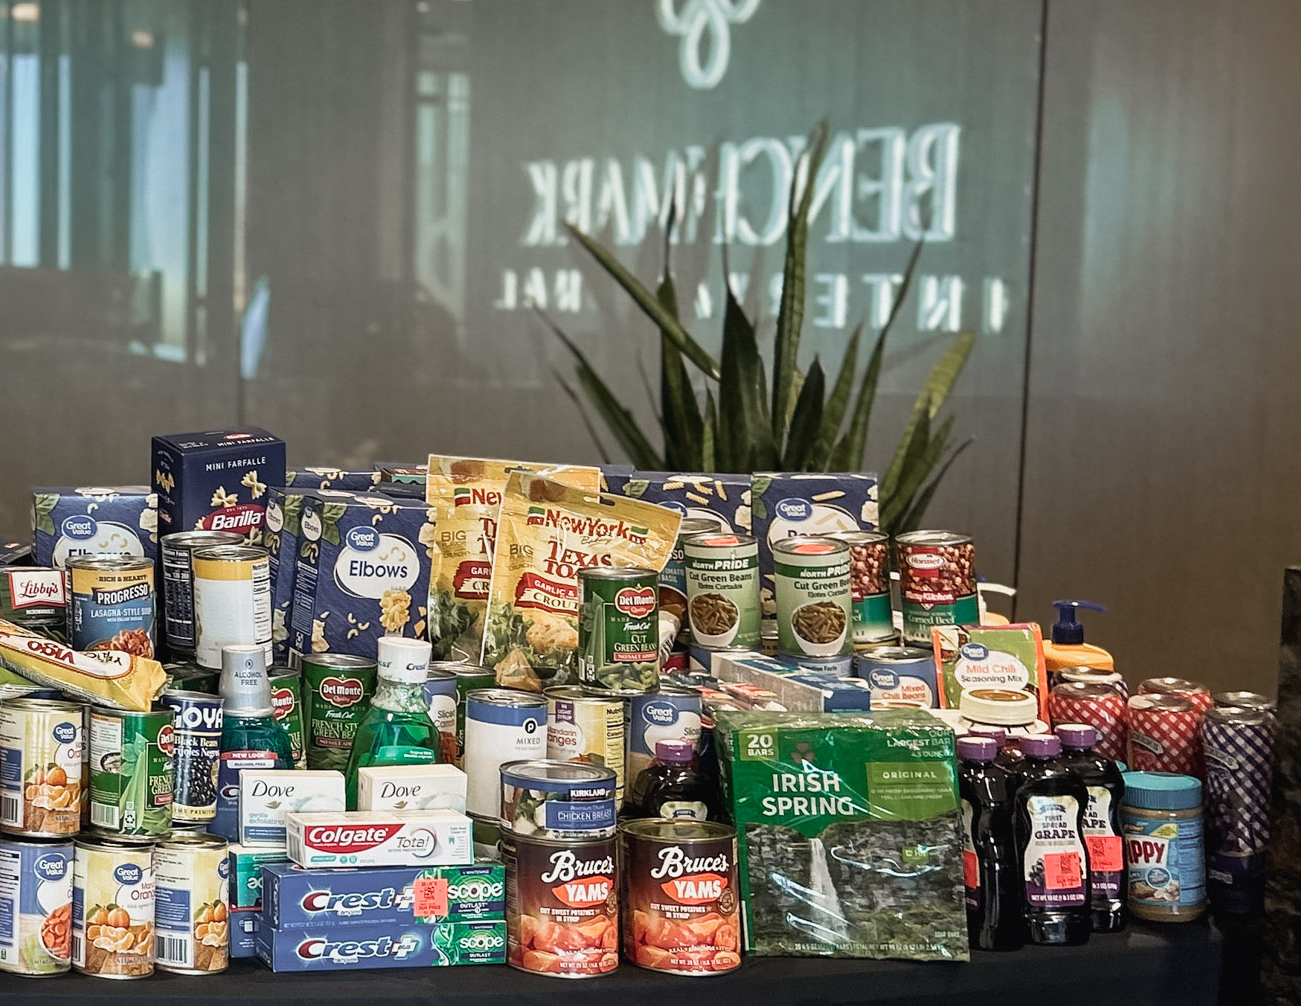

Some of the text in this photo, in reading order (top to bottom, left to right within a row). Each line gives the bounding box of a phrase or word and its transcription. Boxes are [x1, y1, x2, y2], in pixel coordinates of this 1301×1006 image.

[206, 457, 266, 472] MINI FARFALLE
[211, 511, 263, 531] Barilla
[350, 531, 374, 547] Great Value
[349, 560, 408, 579] Elbows
[714, 558, 750, 570] PRIDE
[689, 572, 752, 582] Cut Green Beans
[20, 580, 59, 598] Libby's
[97, 585, 149, 605] PROGRESSO
[91, 608, 140, 618] LASAGNA-STYLE
[966, 664, 1016, 674] Mild Chili
[961, 674, 1022, 684] Seasoning Mix
[747, 735, 773, 748] 20
[772, 772, 841, 792] IRISH
[883, 770, 938, 779] ORIGINAL
[252, 780, 294, 798] Dove
[380, 781, 420, 798] Dove
[570, 788, 606, 797] KIRKLAND
[762, 796, 854, 816] SPRING
[558, 811, 591, 820] CHICKEN
[309, 827, 388, 846] Colgate
[397, 837, 429, 849] Total
[1034, 830, 1076, 840] GRAPE
[542, 850, 614, 882] Bruce's
[650, 846, 729, 878] Bruce's
[448, 884, 503, 900] scope
[564, 882, 608, 902] YAMS
[675, 880, 722, 899] YAMS
[300, 888, 395, 913] Crest
[297, 936, 391, 960] Crest
[459, 935, 503, 950] scope
